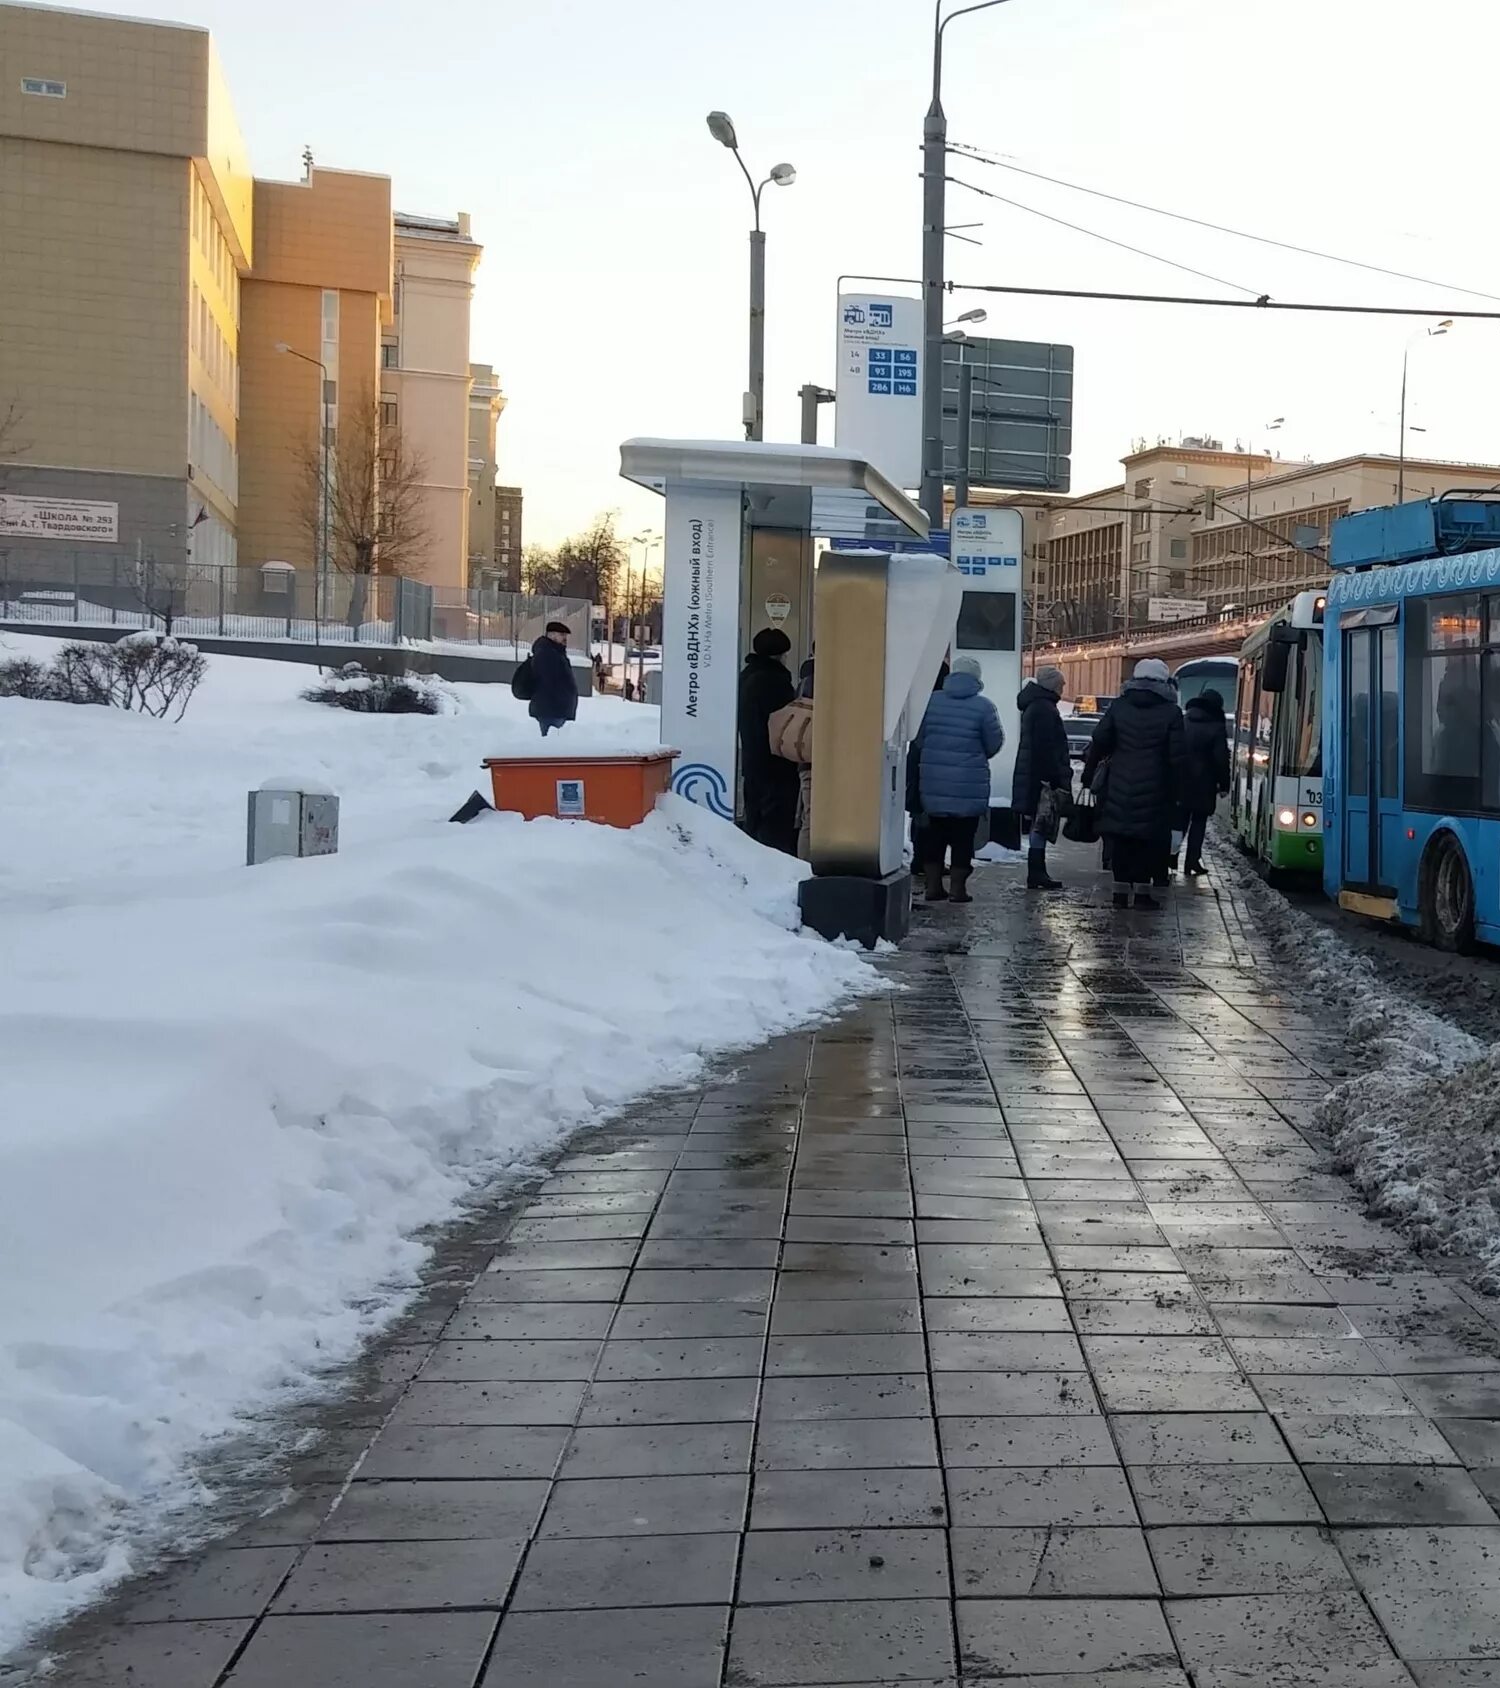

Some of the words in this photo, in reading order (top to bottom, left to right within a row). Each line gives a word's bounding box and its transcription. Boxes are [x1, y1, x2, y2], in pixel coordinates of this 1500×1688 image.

[851, 350, 860, 358] 14
[875, 352, 885, 360] 33
[875, 367, 886, 376] 93
[689, 519, 703, 555] вход)
[687, 558, 702, 610] (южный
[687, 613, 701, 669] «ВДНХ»
[686, 671, 700, 718] Метро
